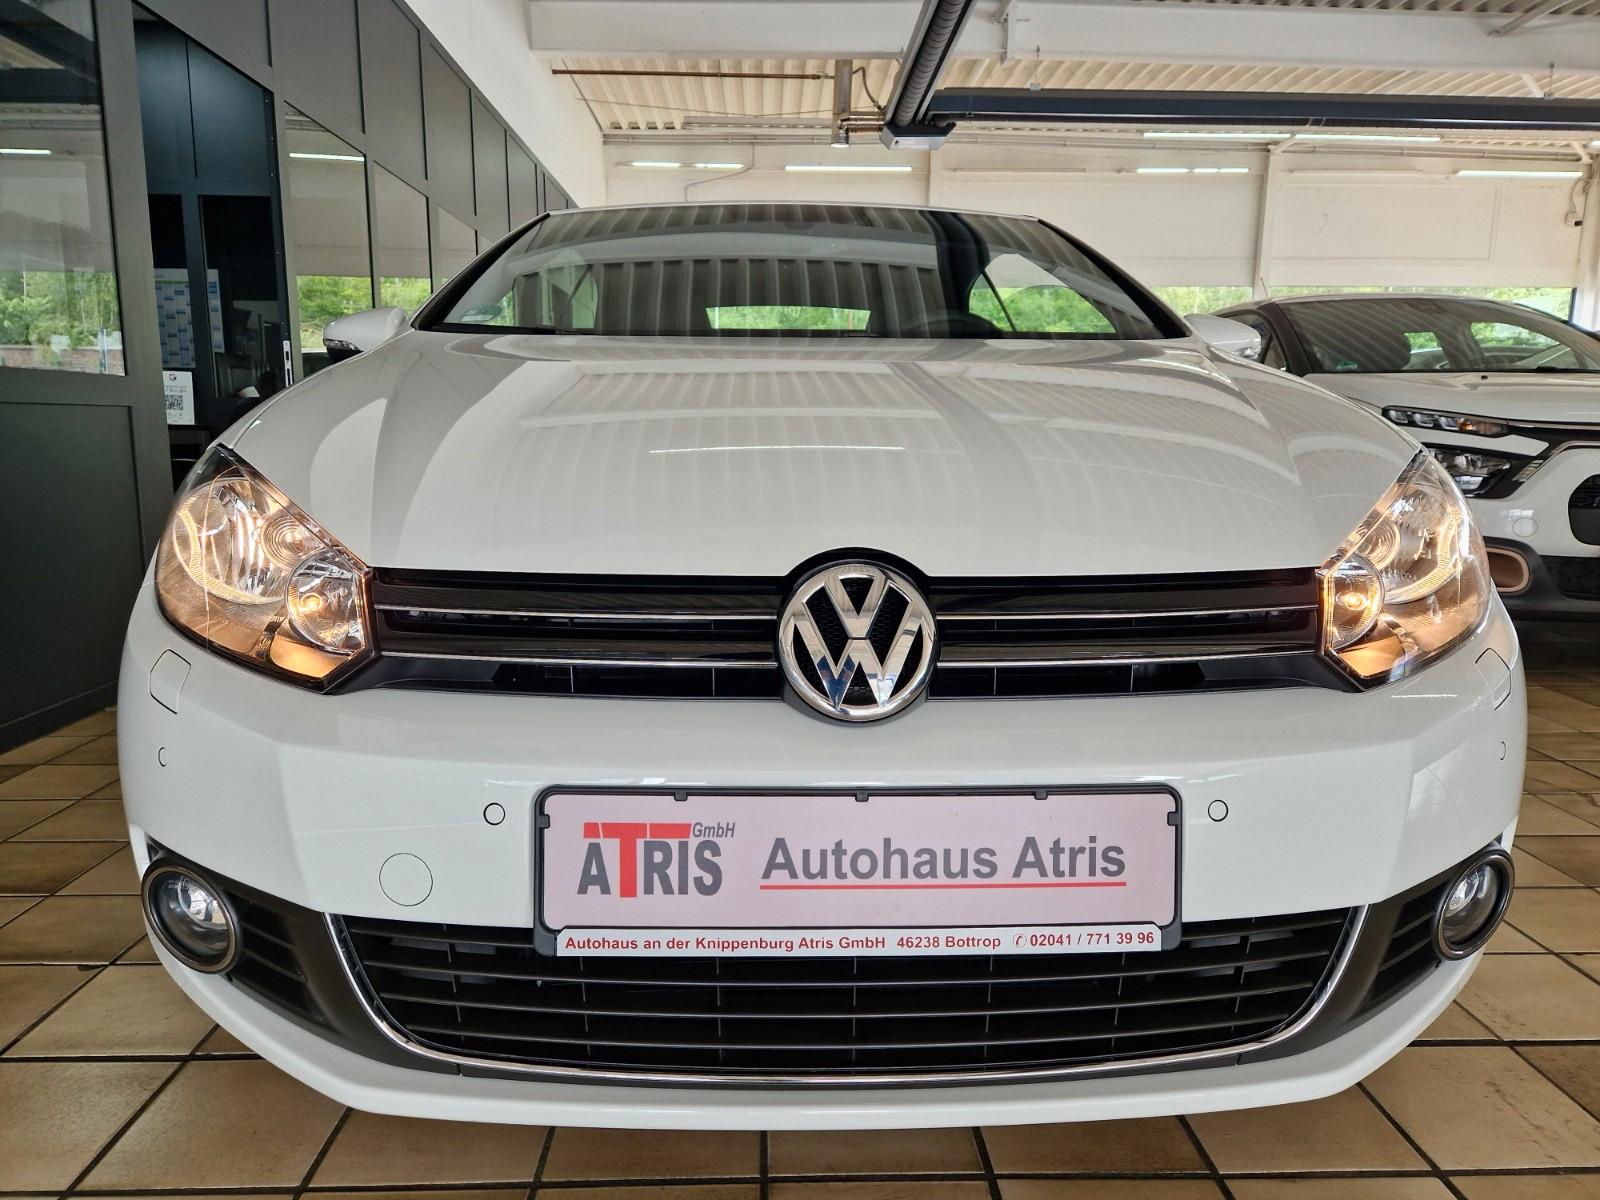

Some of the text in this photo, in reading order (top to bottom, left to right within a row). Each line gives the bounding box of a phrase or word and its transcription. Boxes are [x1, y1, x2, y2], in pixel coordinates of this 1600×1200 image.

[577, 821, 736, 898] ATRIS GmbH
[760, 834, 1127, 880] Autohaus Atris
[565, 936, 638, 950] Autohaus
[643, 939, 661, 949] an
[666, 937, 690, 949] der
[696, 937, 794, 952] Knippenburg
[798, 937, 833, 949] Atris
[838, 936, 886, 949] GmbH
[896, 936, 940, 948] 46238
[945, 936, 1001, 950] Bottrop
[1030, 934, 1071, 947] 02041
[1086, 933, 1111, 945] 771
[1116, 932, 1132, 944] 39
[1137, 931, 1154, 944] 96
